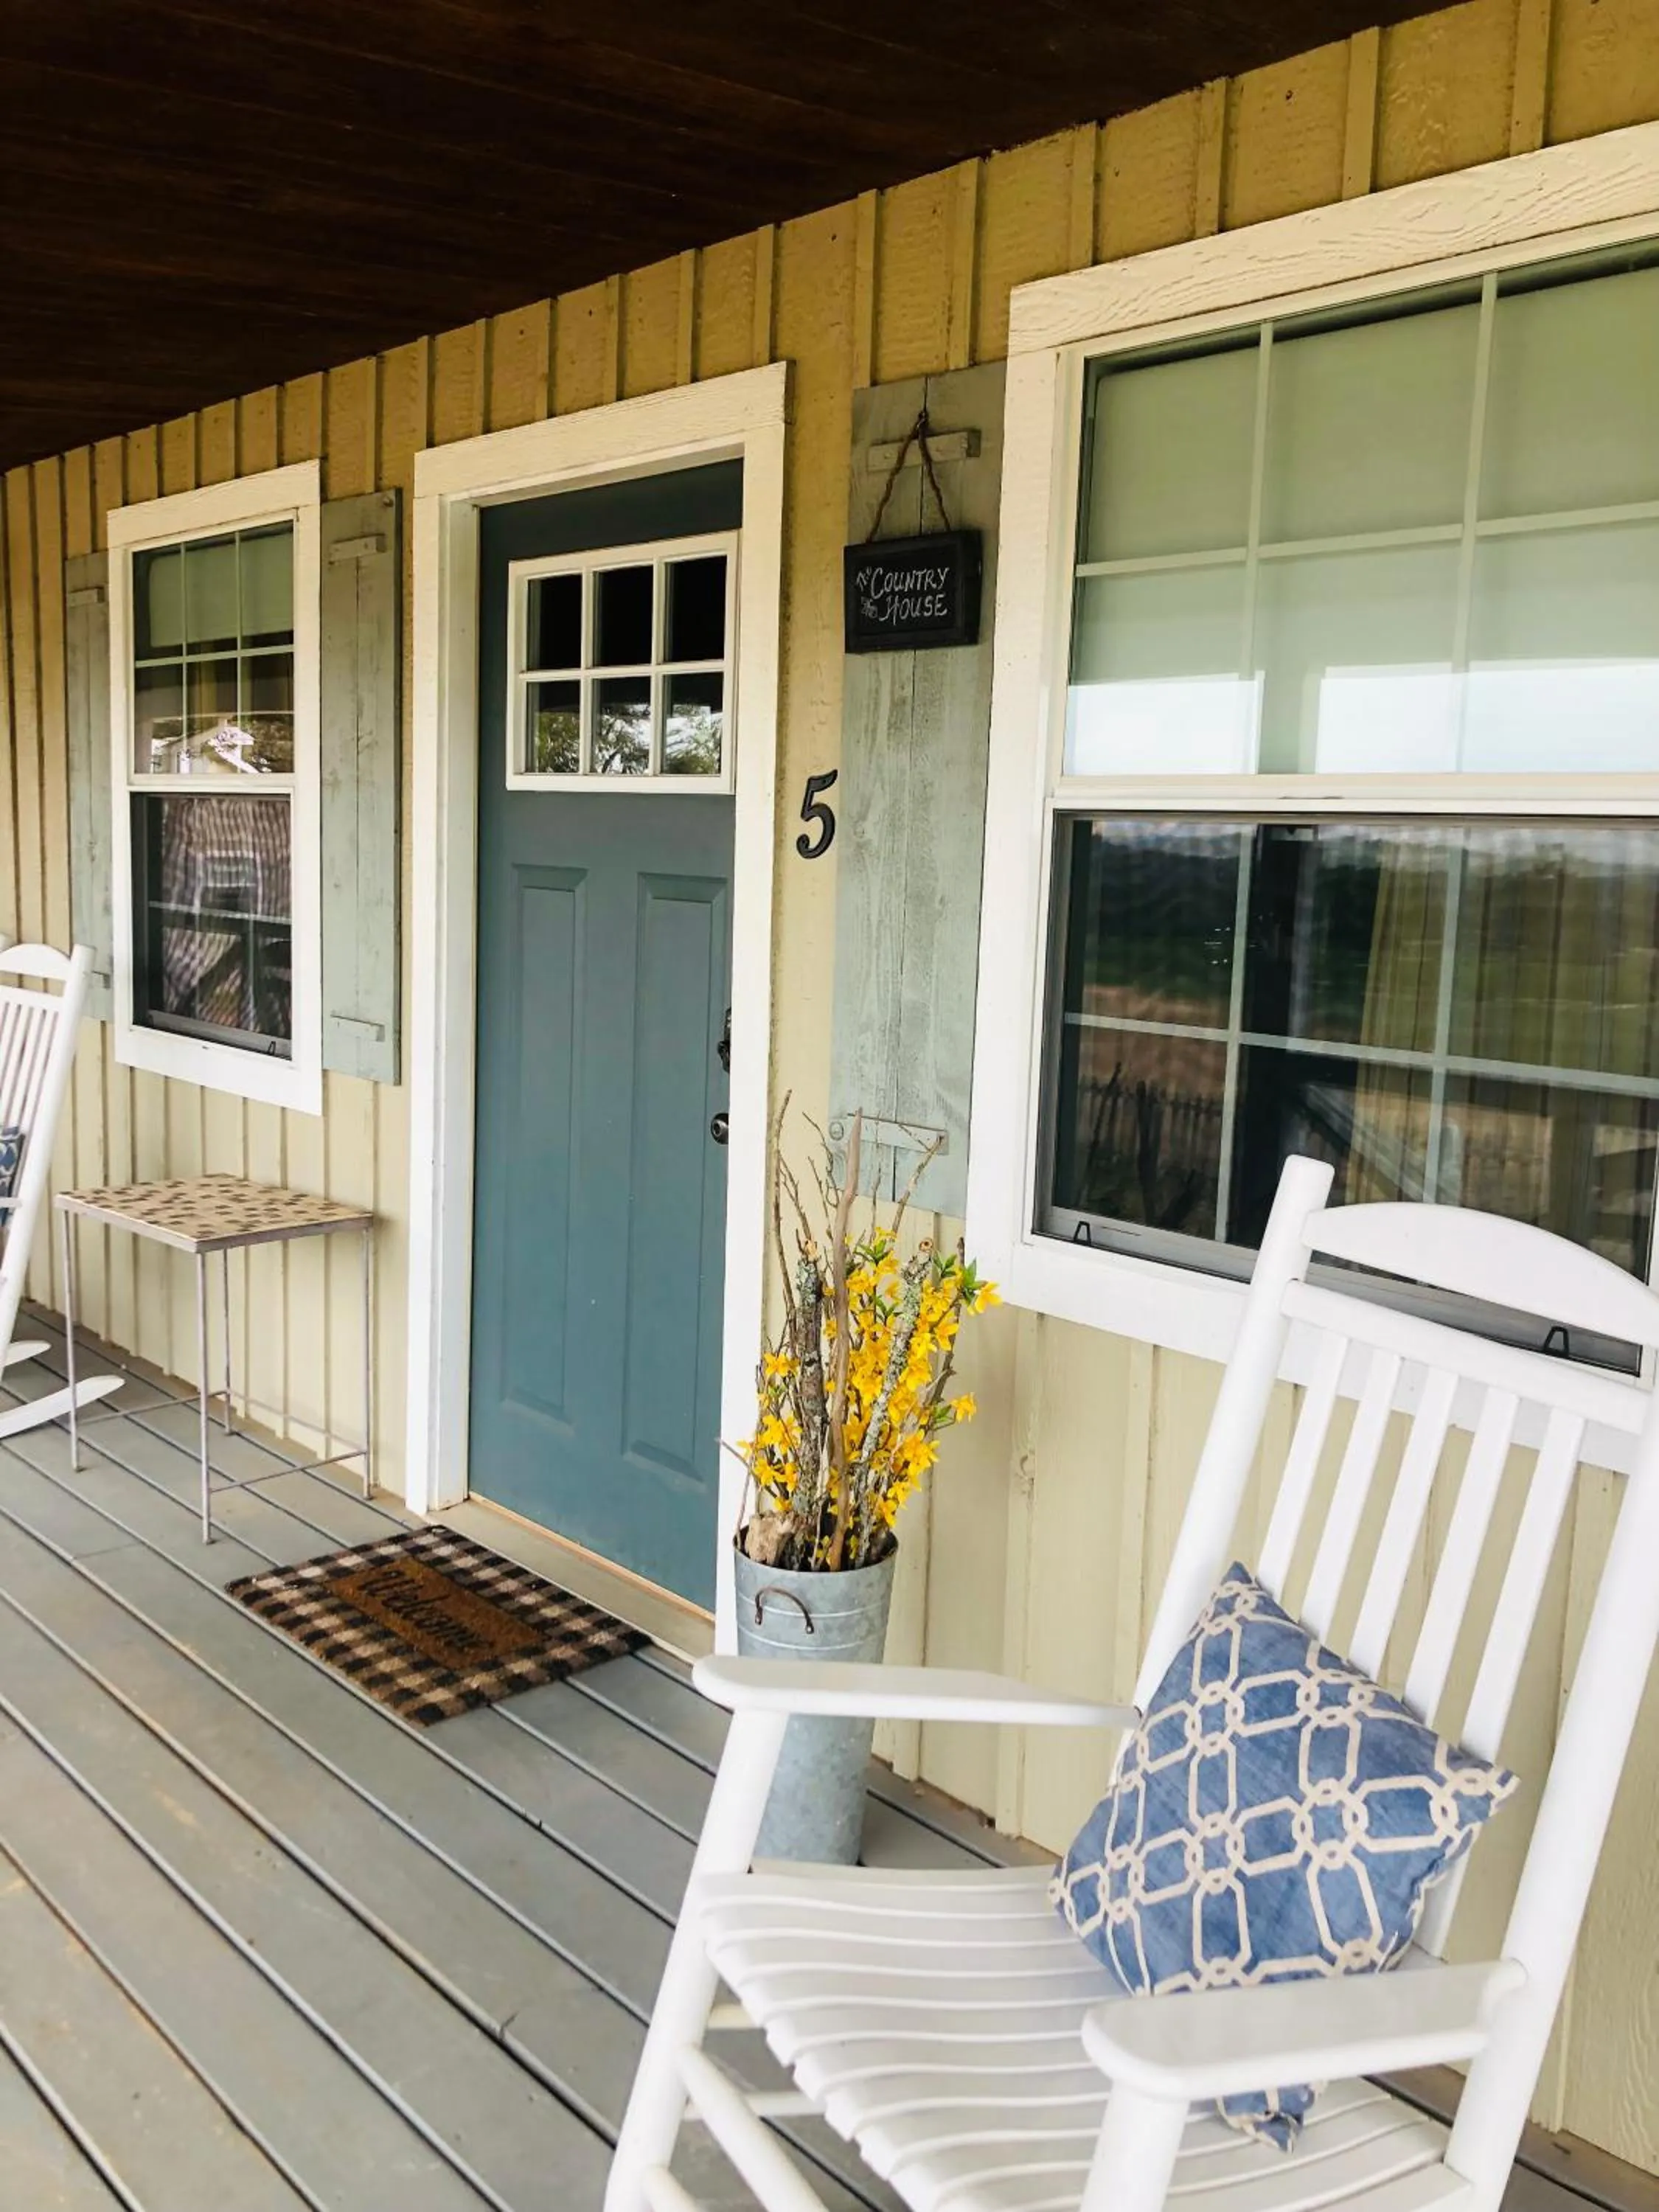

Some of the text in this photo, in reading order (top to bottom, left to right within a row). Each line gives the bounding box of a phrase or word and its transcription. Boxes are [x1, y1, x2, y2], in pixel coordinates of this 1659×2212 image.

[871, 566, 950, 599] COUNTRY
[878, 593, 947, 625] HOUSE
[796, 769, 838, 859] 5
